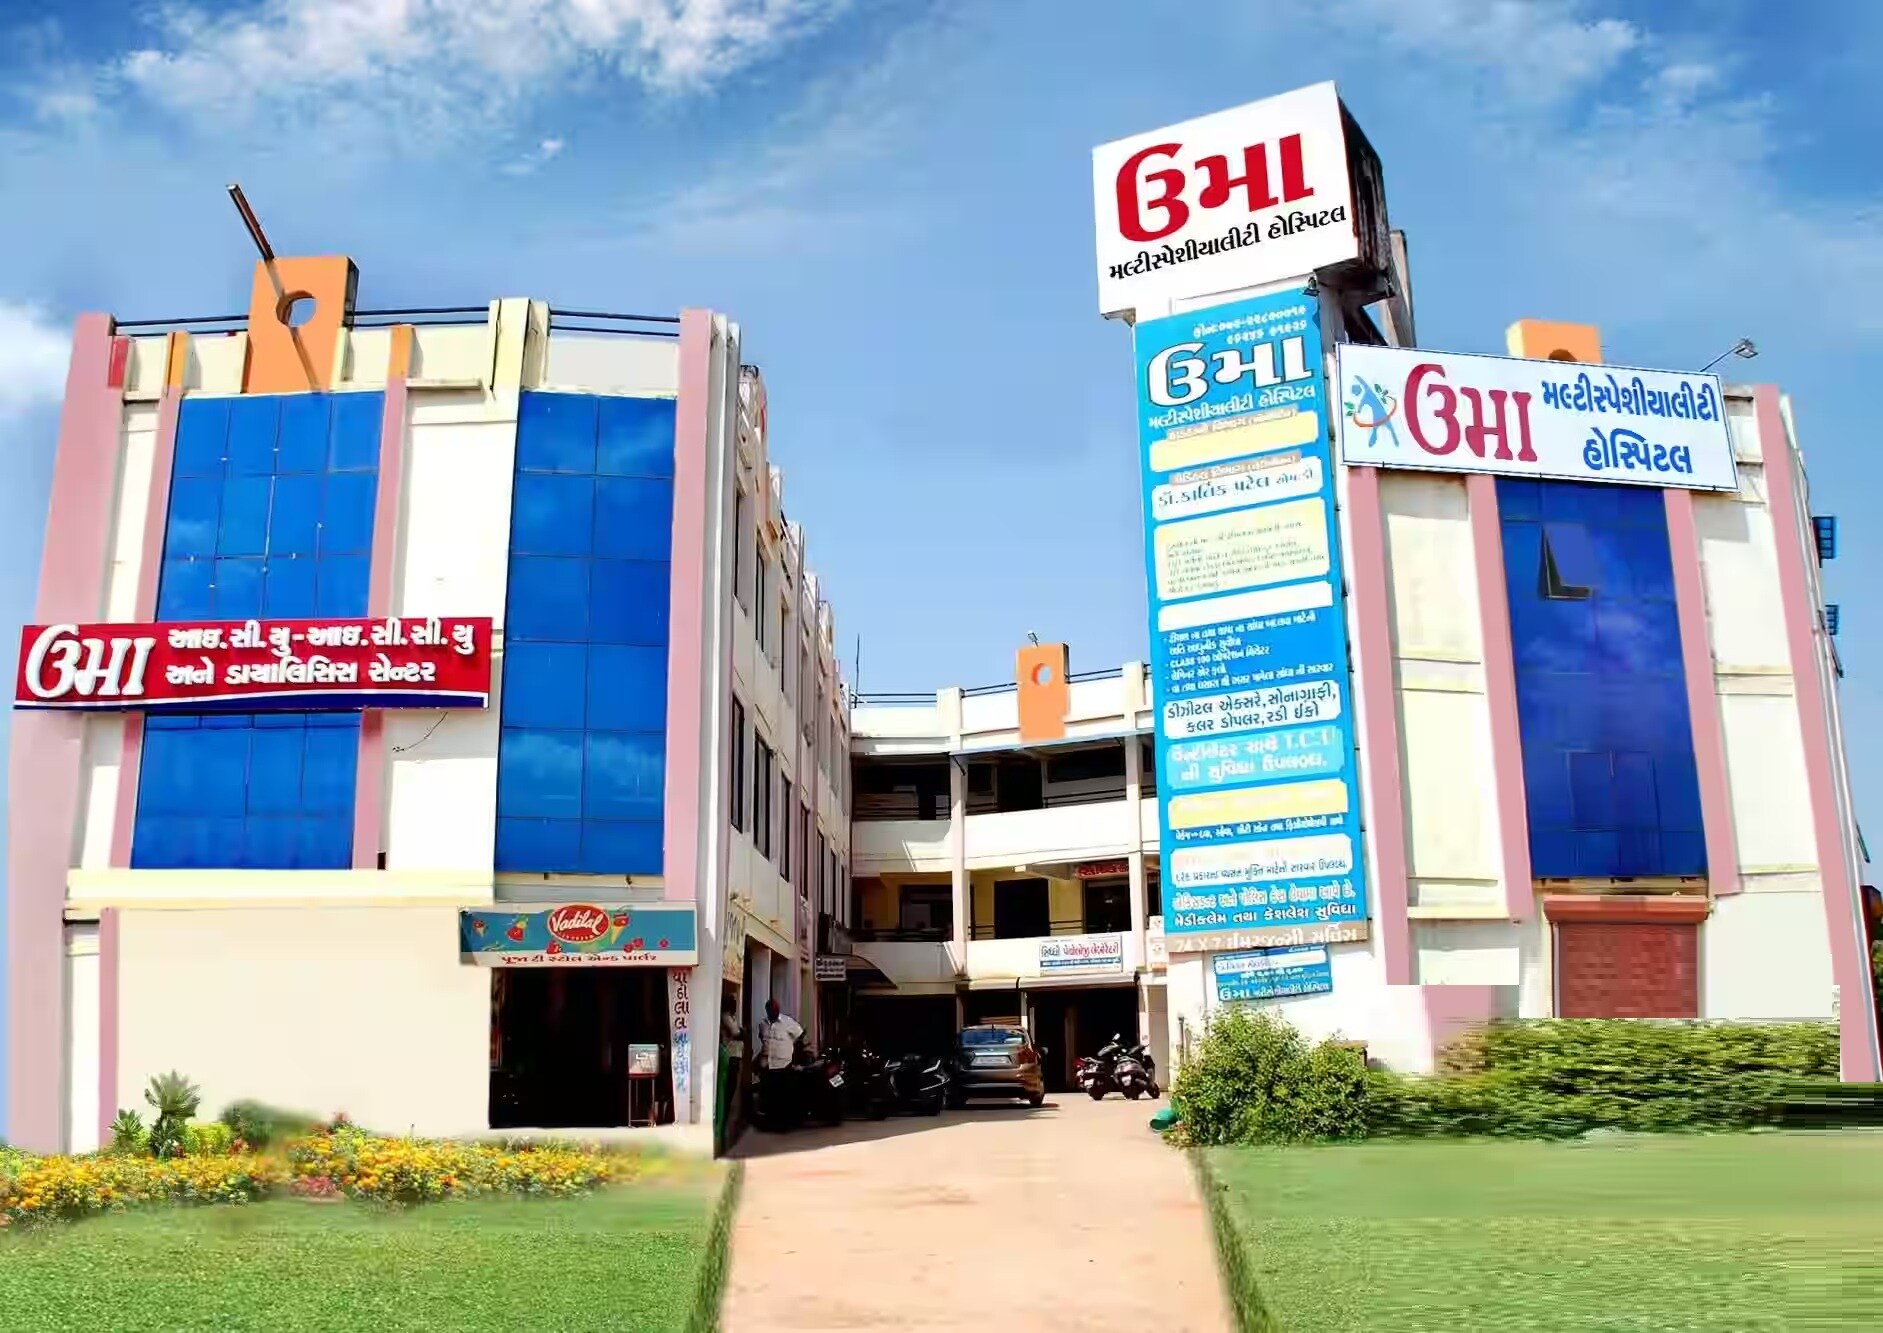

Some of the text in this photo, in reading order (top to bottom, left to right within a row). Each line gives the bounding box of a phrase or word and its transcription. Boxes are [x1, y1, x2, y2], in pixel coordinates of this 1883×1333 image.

[1116, 133, 1314, 242] ઉમા
[1109, 205, 1347, 280] મલ્ટીસ્પેશીયાલીટી હોસ્પિટલ
[1148, 337, 1313, 406] ઉમા
[1149, 394, 1254, 428] મલ્ટીસ્પેશીયાલીટી
[1258, 384, 1316, 407] હોસ્પિટલ
[1403, 363, 1538, 463] ઉમા
[1541, 372, 1720, 422] મલ્ટીસ્પેશીયાલીટી
[1582, 427, 1694, 474] હોસ્પિટલ
[24, 623, 157, 699] ઉમા
[165, 652, 437, 685] અને ડાયાલિસિસ સેન્ટર
[1167, 700, 1214, 719] ડીઝીટલ
[1186, 718, 1215, 733] કલર
[551, 911, 604, 936] Vadilal
[1232, 911, 1257, 923] તથા
[1315, 902, 1356, 921] સુવિધા
